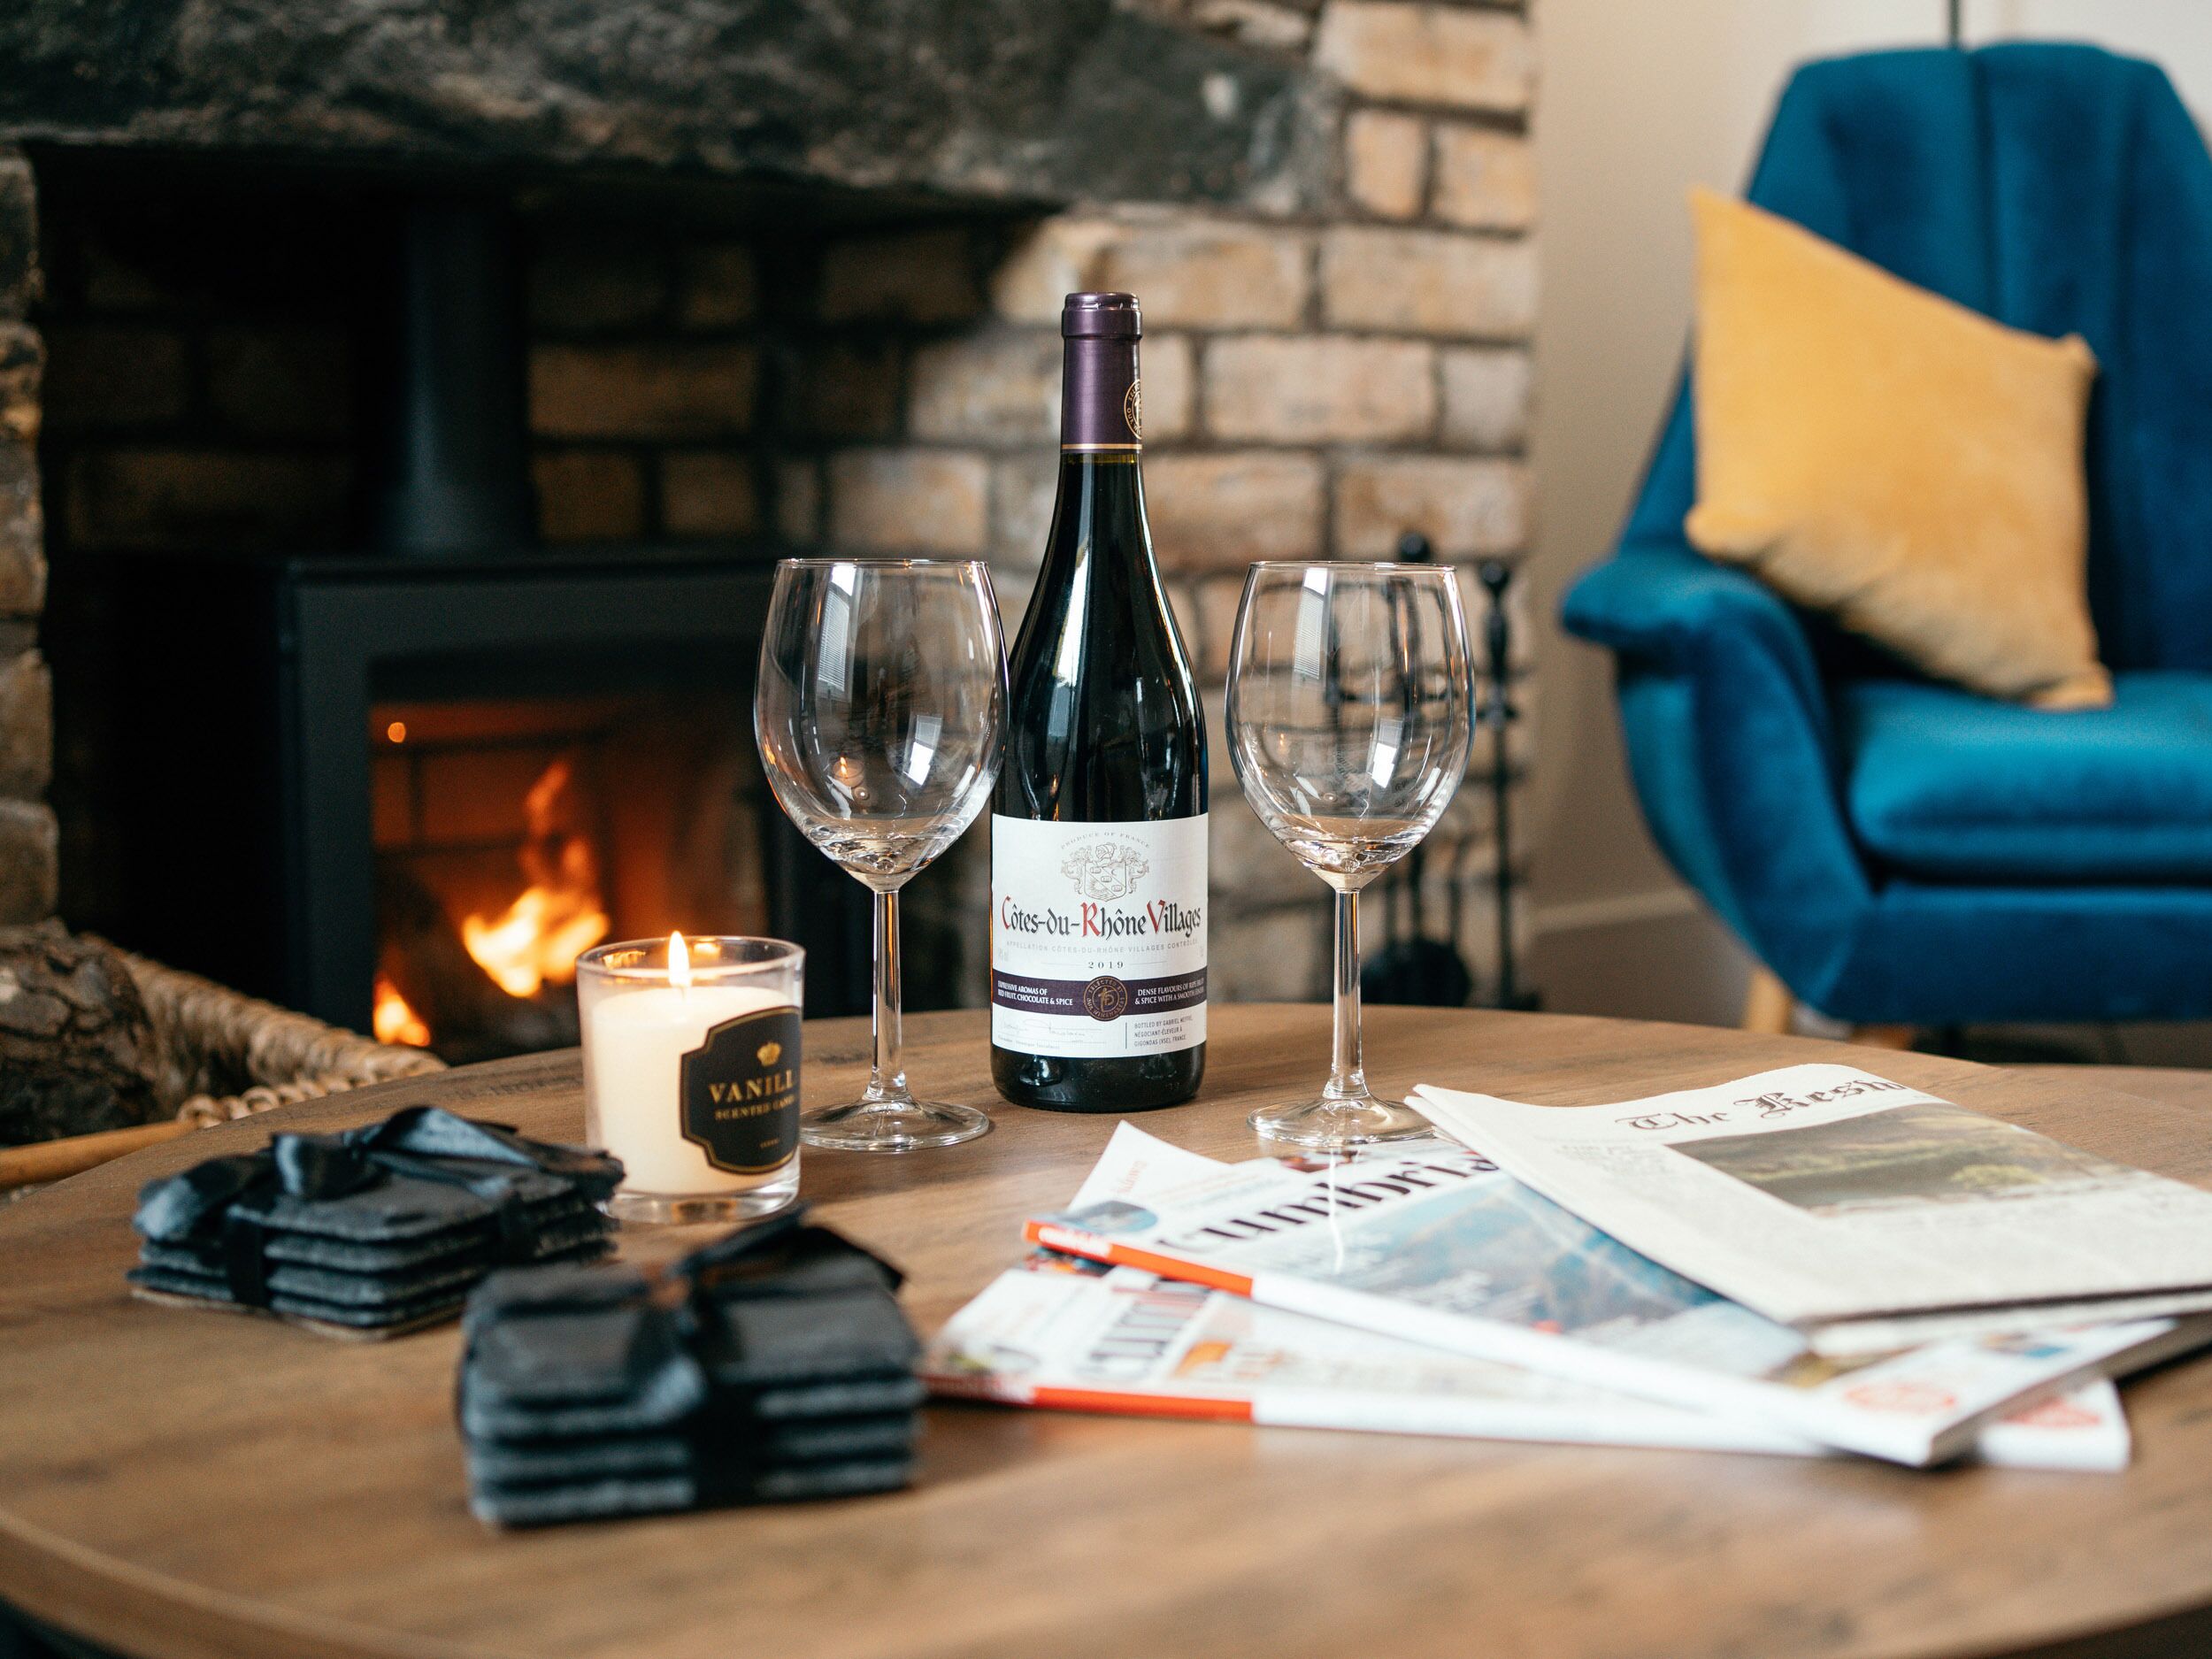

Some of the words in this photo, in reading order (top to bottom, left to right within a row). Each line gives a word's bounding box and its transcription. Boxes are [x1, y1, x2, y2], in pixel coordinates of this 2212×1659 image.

[1119, 833, 1149, 849] FRANCE
[1002, 895, 1146, 941] Côtes-du-Rhône
[1147, 899, 1202, 938] Villages
[1006, 941, 1048, 951] APPELLATION
[1051, 943, 1124, 954] CÔTES-DU-RHÔNE
[1128, 943, 1165, 953] VILLAGES
[1018, 985, 1039, 995] AROMAS
[1039, 987, 1048, 996] OF
[1137, 987, 1157, 996] DENSE
[1157, 984, 1183, 995] FLAVOURS
[1017, 993, 1048, 1004] CHOCOLATE
[1056, 997, 1073, 1006] SPICE
[1141, 996, 1157, 1005] SPICE
[1134, 1020, 1155, 1029] BOTTLED
[1615, 1111, 1732, 1131] The
